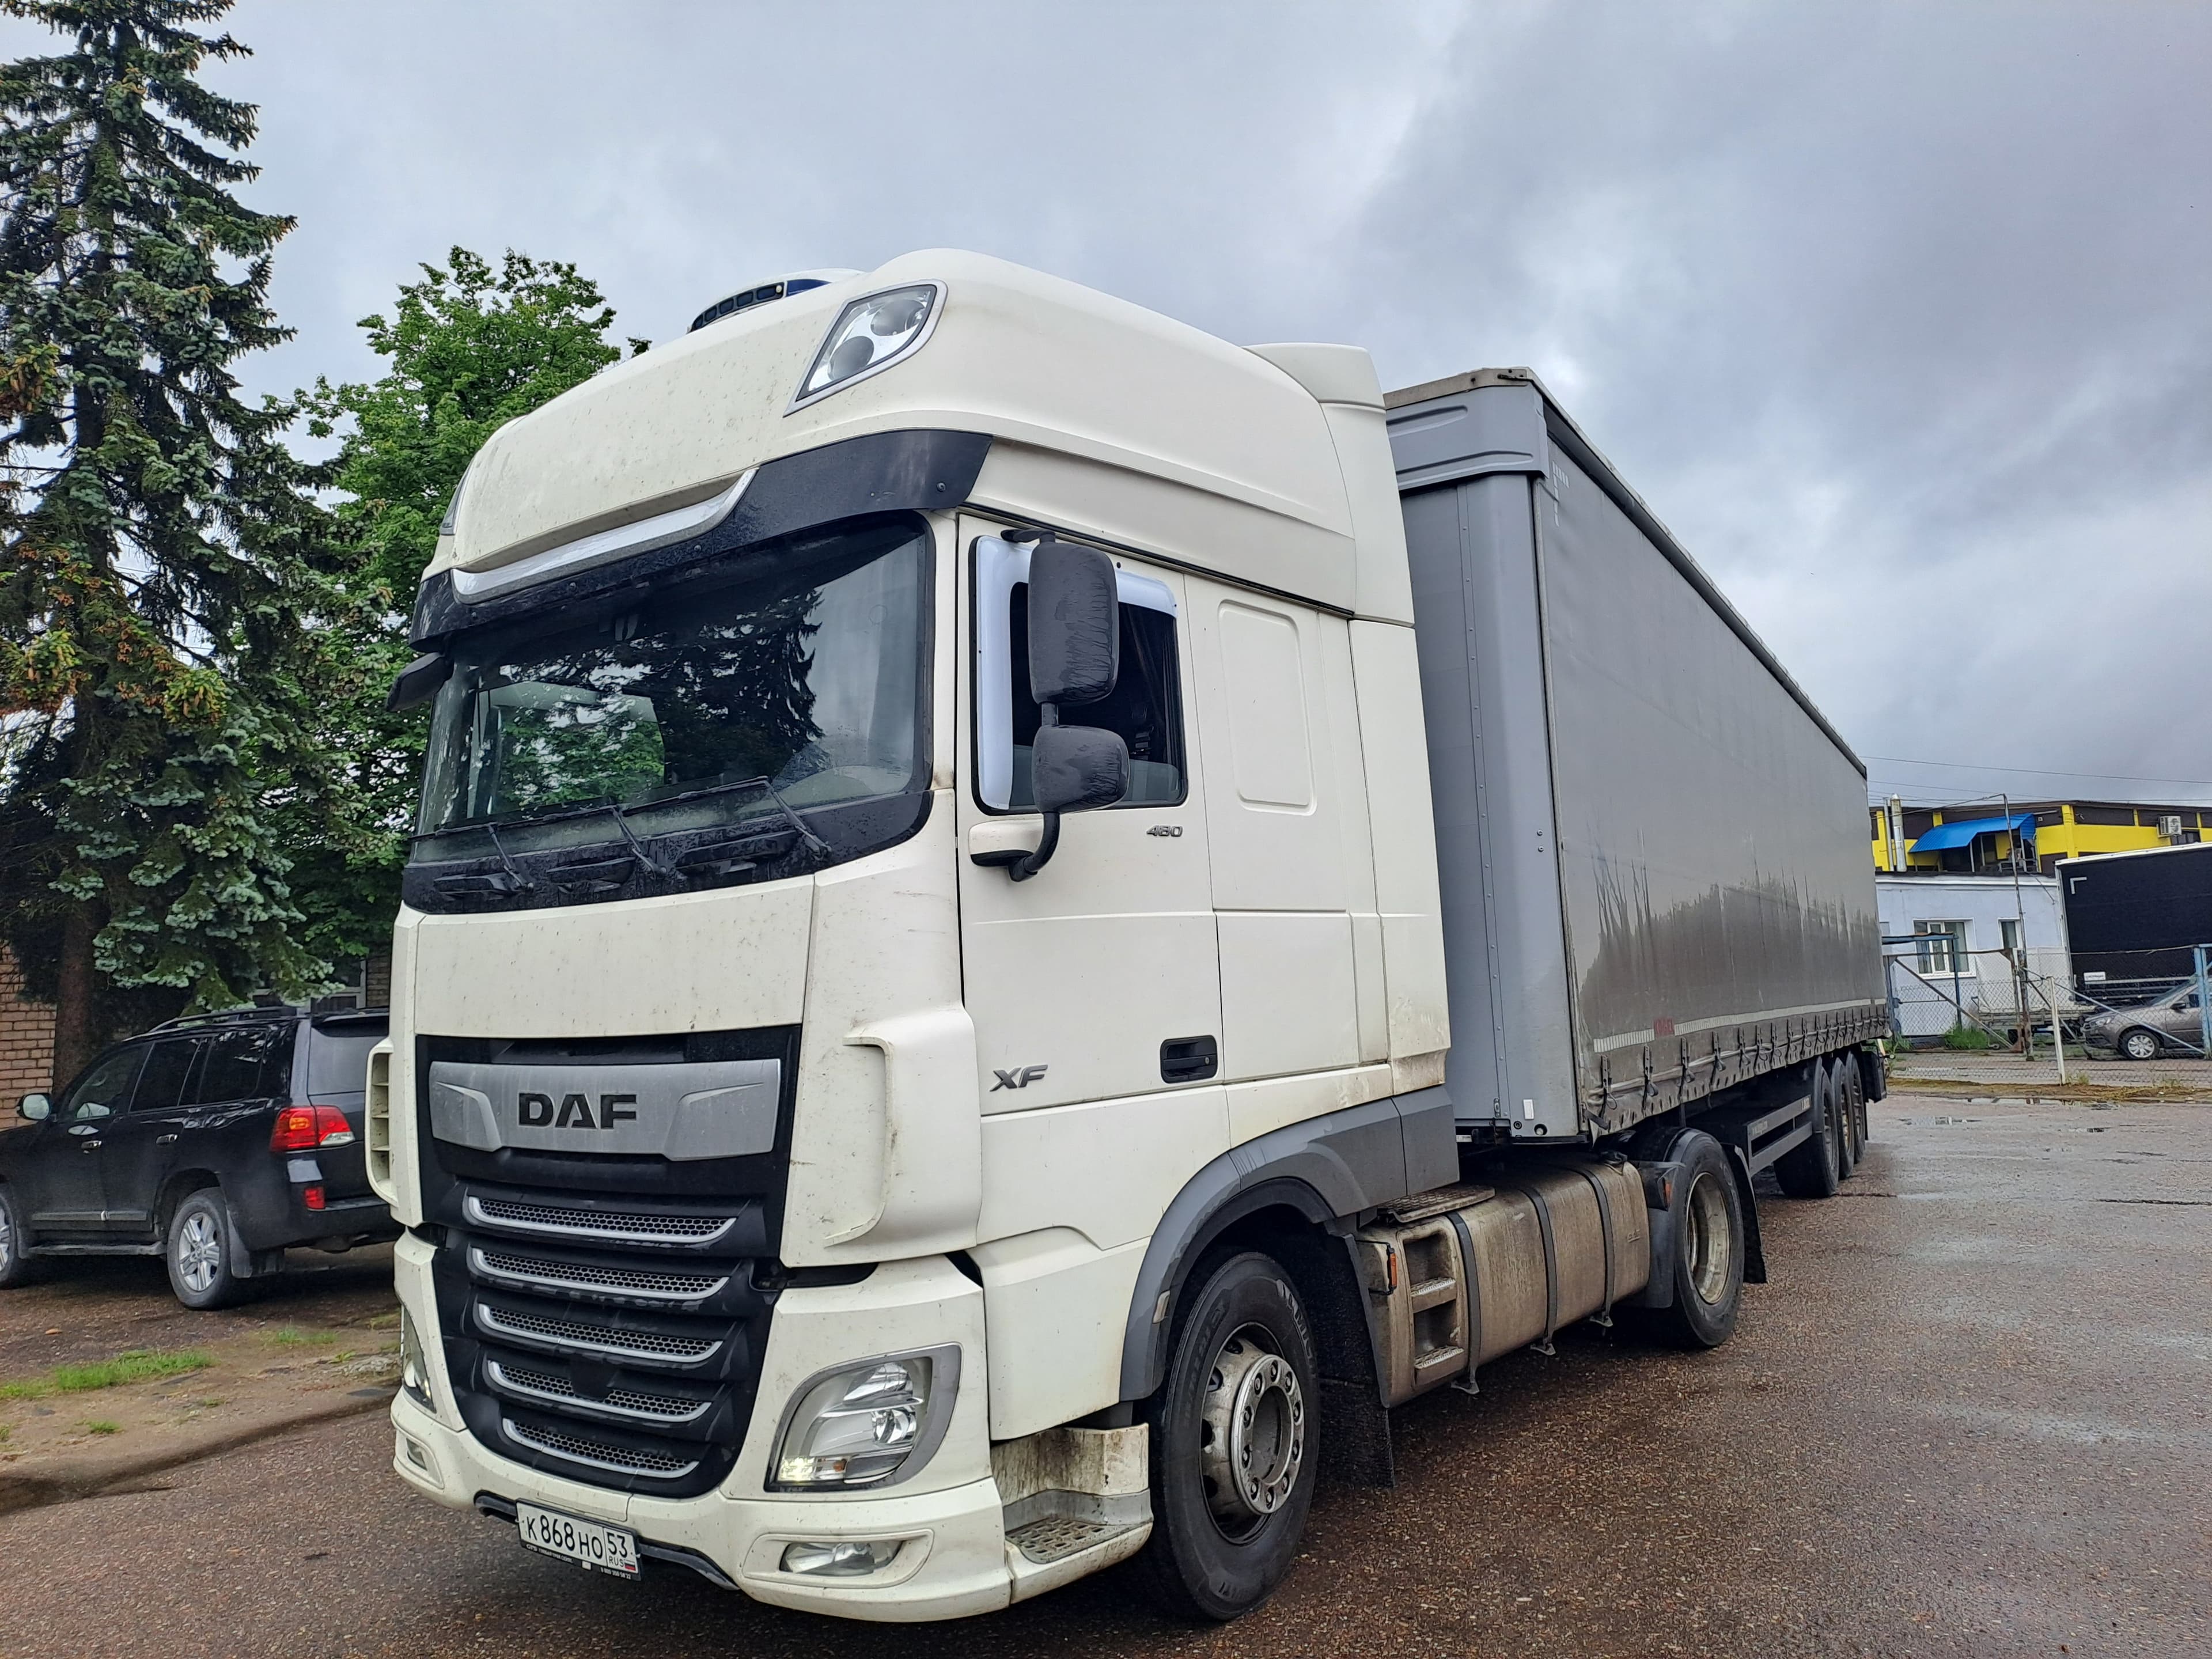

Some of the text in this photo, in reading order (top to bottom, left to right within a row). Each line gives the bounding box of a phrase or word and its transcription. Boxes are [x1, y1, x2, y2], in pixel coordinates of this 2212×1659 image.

[1146, 824, 1183, 838] 480
[989, 1064, 1048, 1092] XF
[518, 1092, 637, 1130] DAF
[607, 1532, 628, 1558] 53
[608, 1555, 624, 1567] RUS
